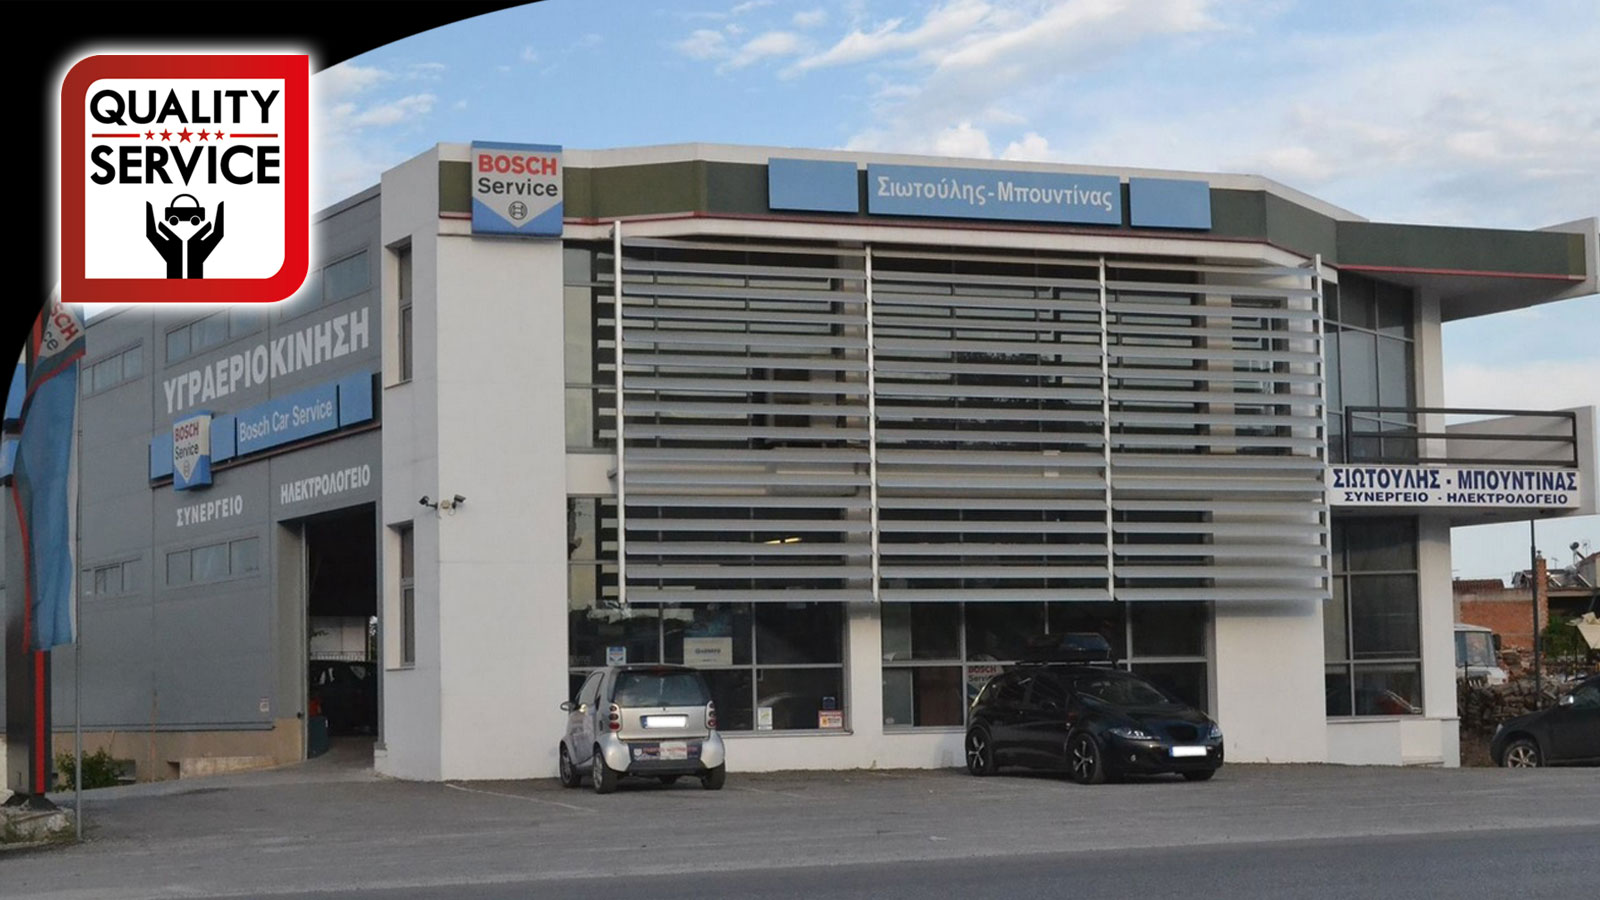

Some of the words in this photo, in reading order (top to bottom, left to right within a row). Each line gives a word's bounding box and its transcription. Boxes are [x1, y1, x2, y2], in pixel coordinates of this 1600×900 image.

[478, 154, 557, 175] BOSCH
[478, 177, 558, 197] Service
[163, 306, 369, 414] ΥΓΡΑΕΡΙΟΚΙΝΗΣΗ
[175, 421, 199, 442] BOSCH
[239, 415, 270, 442] Bosch
[272, 411, 290, 432] Car
[292, 399, 333, 427] Service
[175, 442, 199, 461] Service
[280, 464, 371, 505] ΗΛΕΚΤΡΟΛΟΓΕΙΟ
[1333, 468, 1441, 489] ΣΙΩΤΟΥΛΗΣ
[1457, 470, 1577, 491] ΜΠΟΥΝΤΙΝΑΣ
[1344, 491, 1429, 503] ΣΥΝΕΡΓΕΙΟ
[1446, 493, 1568, 504] ΗΛΕΚΤΡΟΛΟΓΕΙΟ
[176, 495, 243, 527] ΣΥΝΕΡΓΕΙΟ
